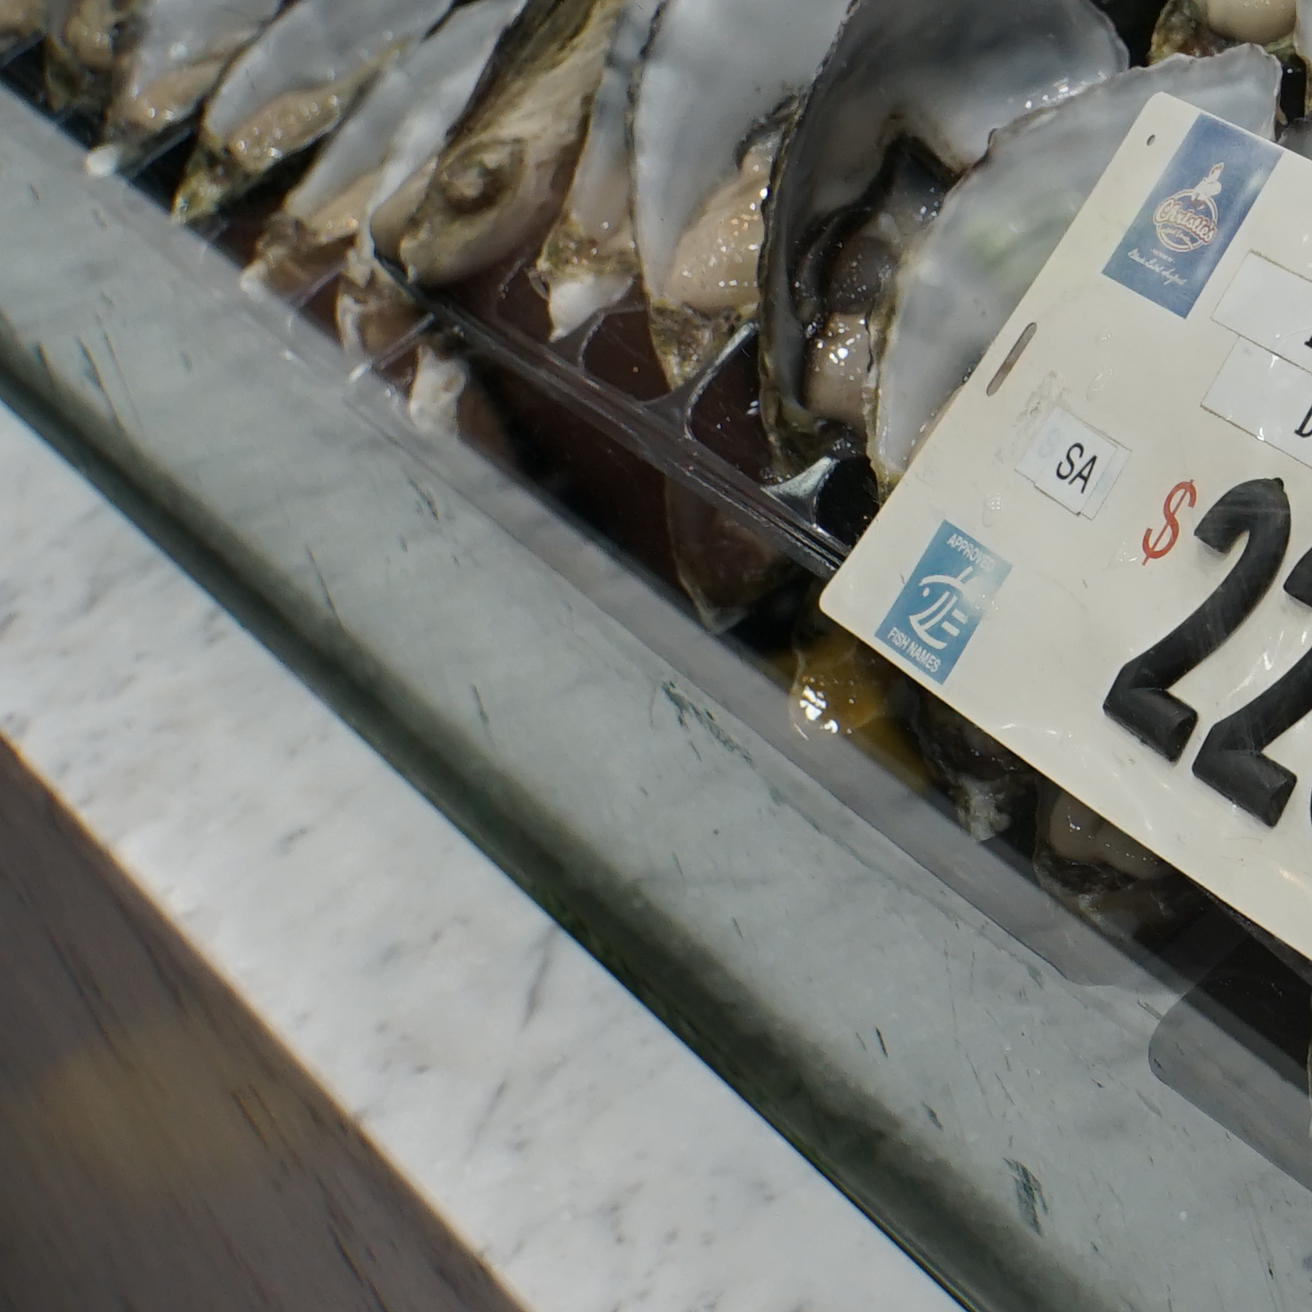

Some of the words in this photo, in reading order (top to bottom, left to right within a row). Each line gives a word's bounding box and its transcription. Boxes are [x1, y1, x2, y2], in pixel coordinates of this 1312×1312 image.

[1056, 442, 1098, 494] SA
[946, 533, 997, 572] APPROVED
[887, 626, 912, 651] FISH
[907, 639, 942, 673] NAMES
